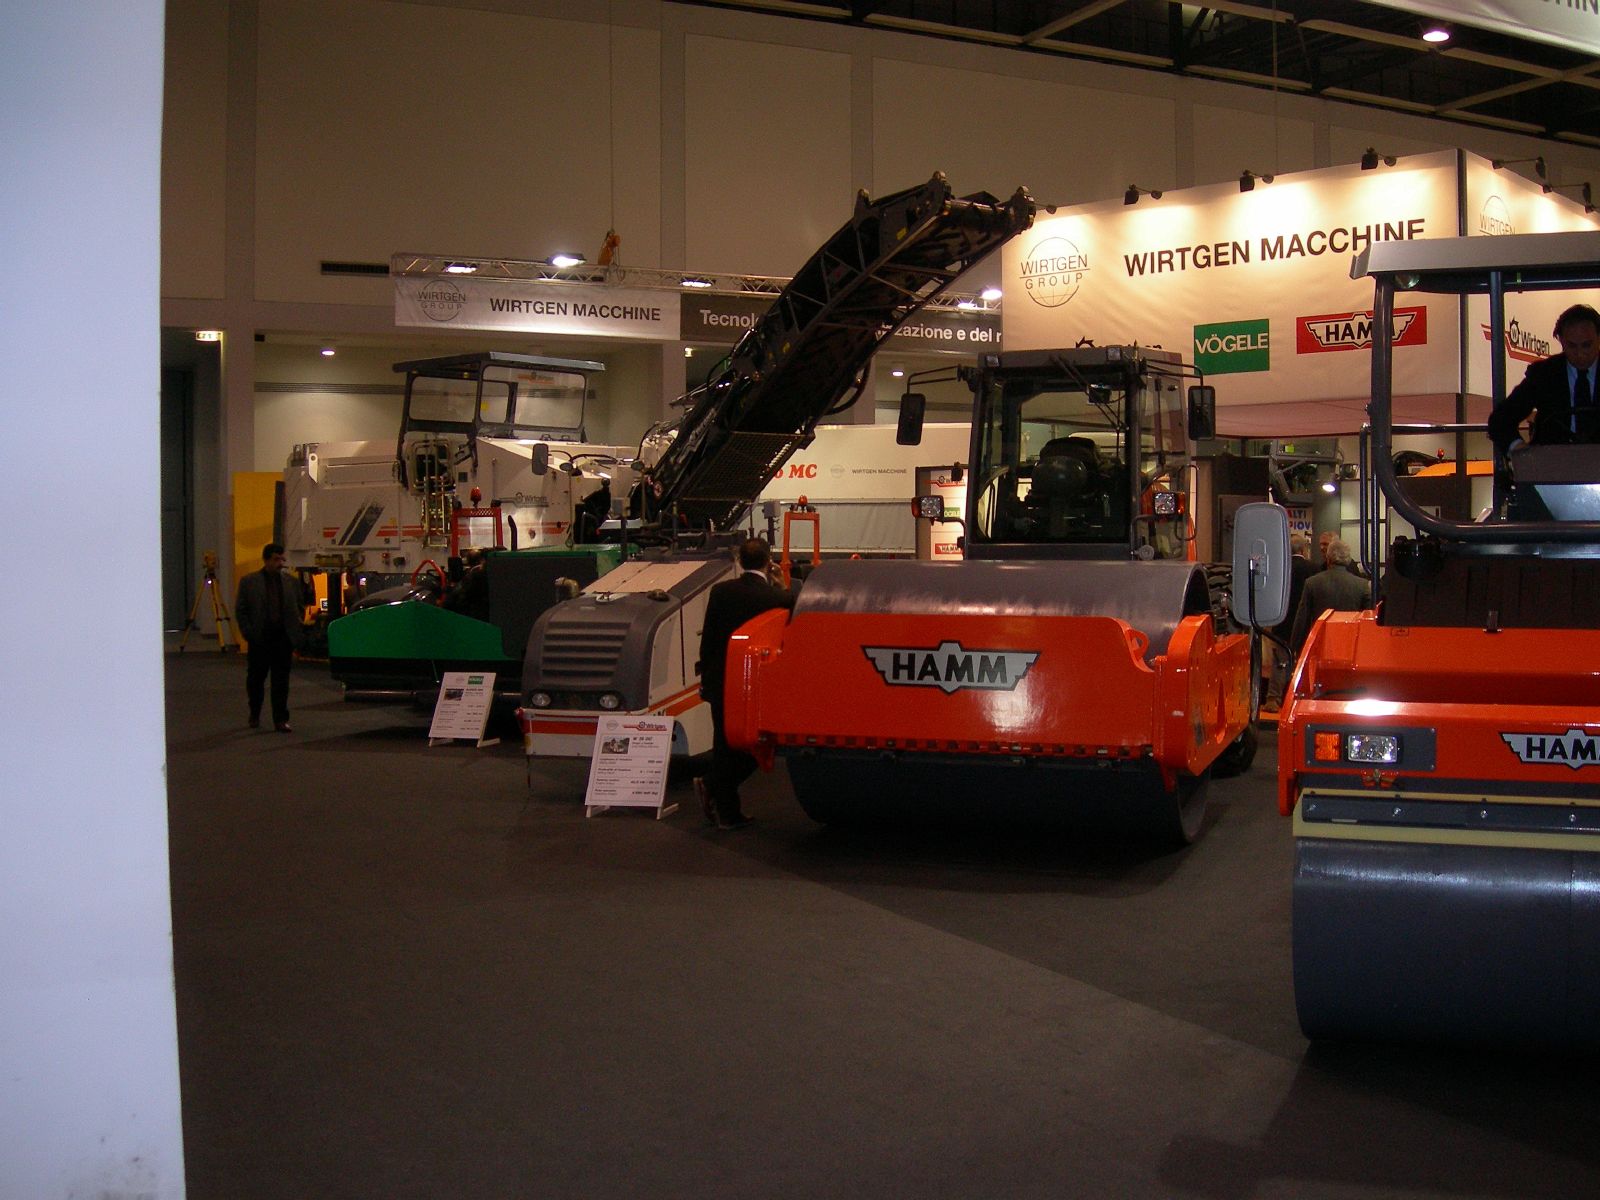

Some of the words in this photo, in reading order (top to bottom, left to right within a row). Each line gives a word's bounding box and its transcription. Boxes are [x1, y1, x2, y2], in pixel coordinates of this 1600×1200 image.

[1020, 253, 1089, 276] WIRTGEN
[1123, 239, 1250, 277] WIRTGEN
[1025, 271, 1084, 290] GROUP
[417, 290, 467, 302] WIRTGEN
[420, 302, 463, 310] GROUP
[490, 298, 568, 316] WIRTGEN
[572, 303, 661, 321] MACCHINE
[893, 323, 952, 341] zazione
[956, 329, 967, 341] e
[970, 327, 992, 342] del
[1195, 332, 1269, 355] VÖGELE
[1325, 322, 1396, 343] HAM
[1521, 331, 1550, 356] Wirtgen
[788, 463, 818, 479] MC
[892, 652, 1008, 684] HAMM
[1526, 737, 1600, 760] HAM
